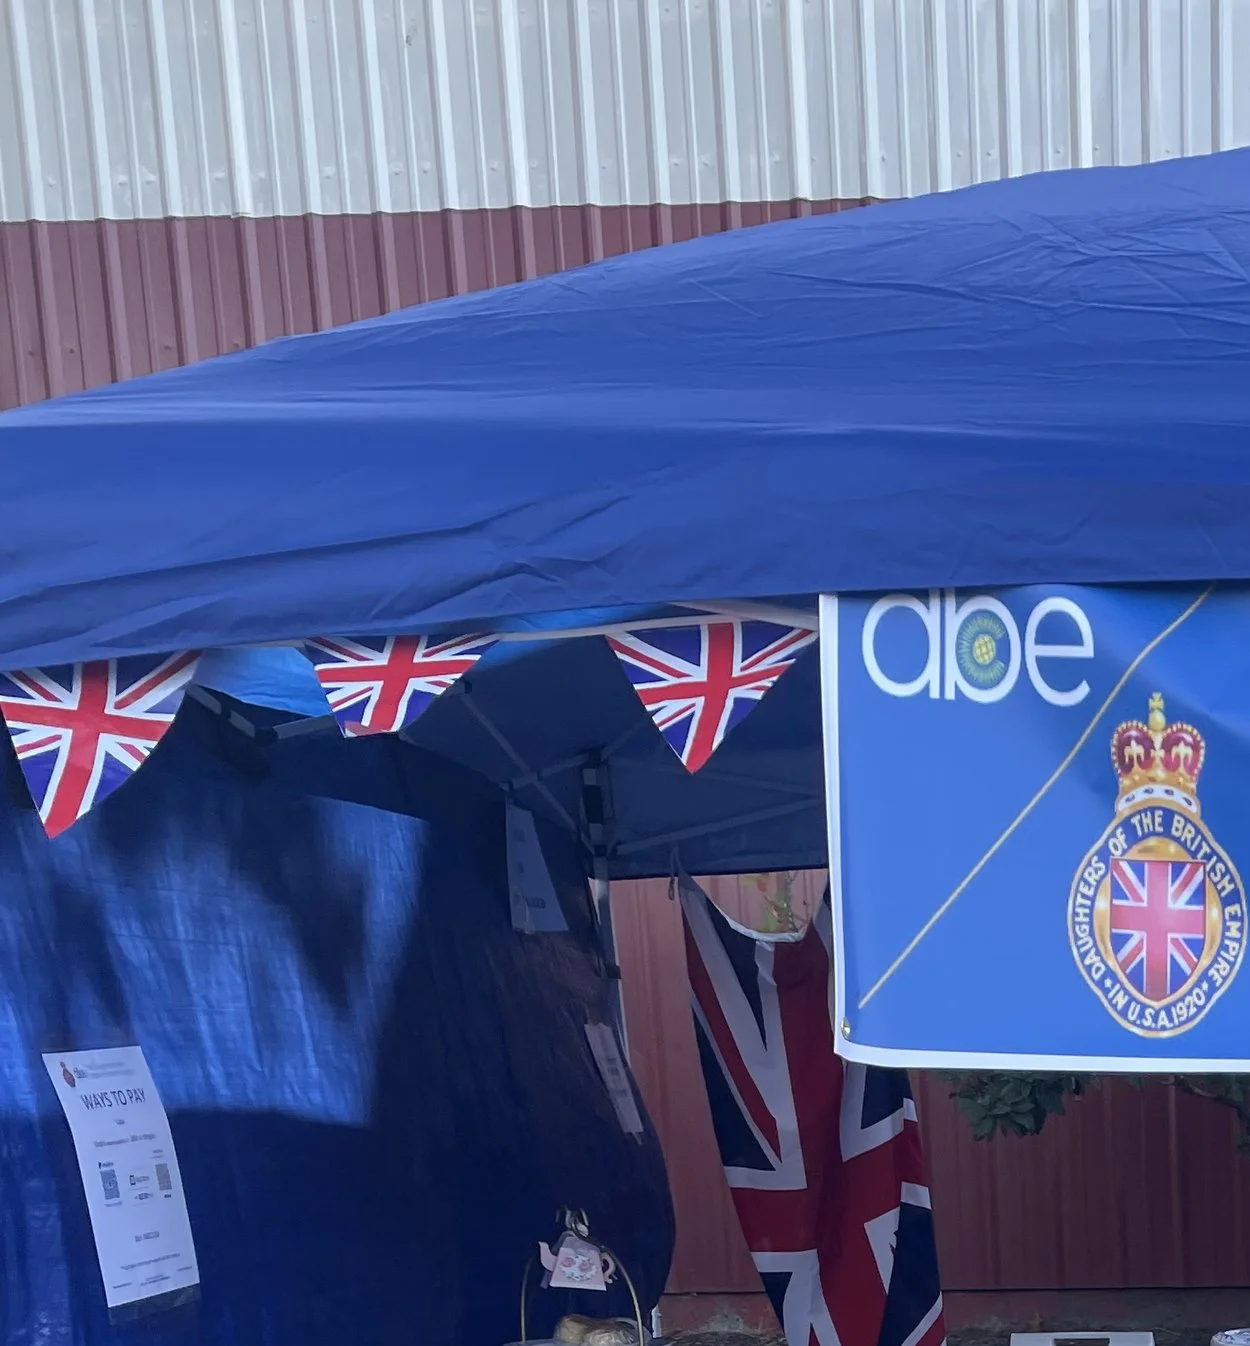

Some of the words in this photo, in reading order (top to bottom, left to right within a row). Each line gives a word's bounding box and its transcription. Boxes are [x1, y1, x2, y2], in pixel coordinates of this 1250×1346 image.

[1074, 855, 1107, 982] DAUGHTERS
[1107, 827, 1128, 857] OF
[1131, 809, 1164, 837] THE
[1170, 814, 1235, 897] BRITISH
[1207, 903, 1243, 988] EMPIRE
[1107, 982, 1129, 1012] IN
[80, 1091, 113, 1111] WAYS
[110, 1090, 127, 1106] TO
[127, 1087, 146, 1104] PAY
